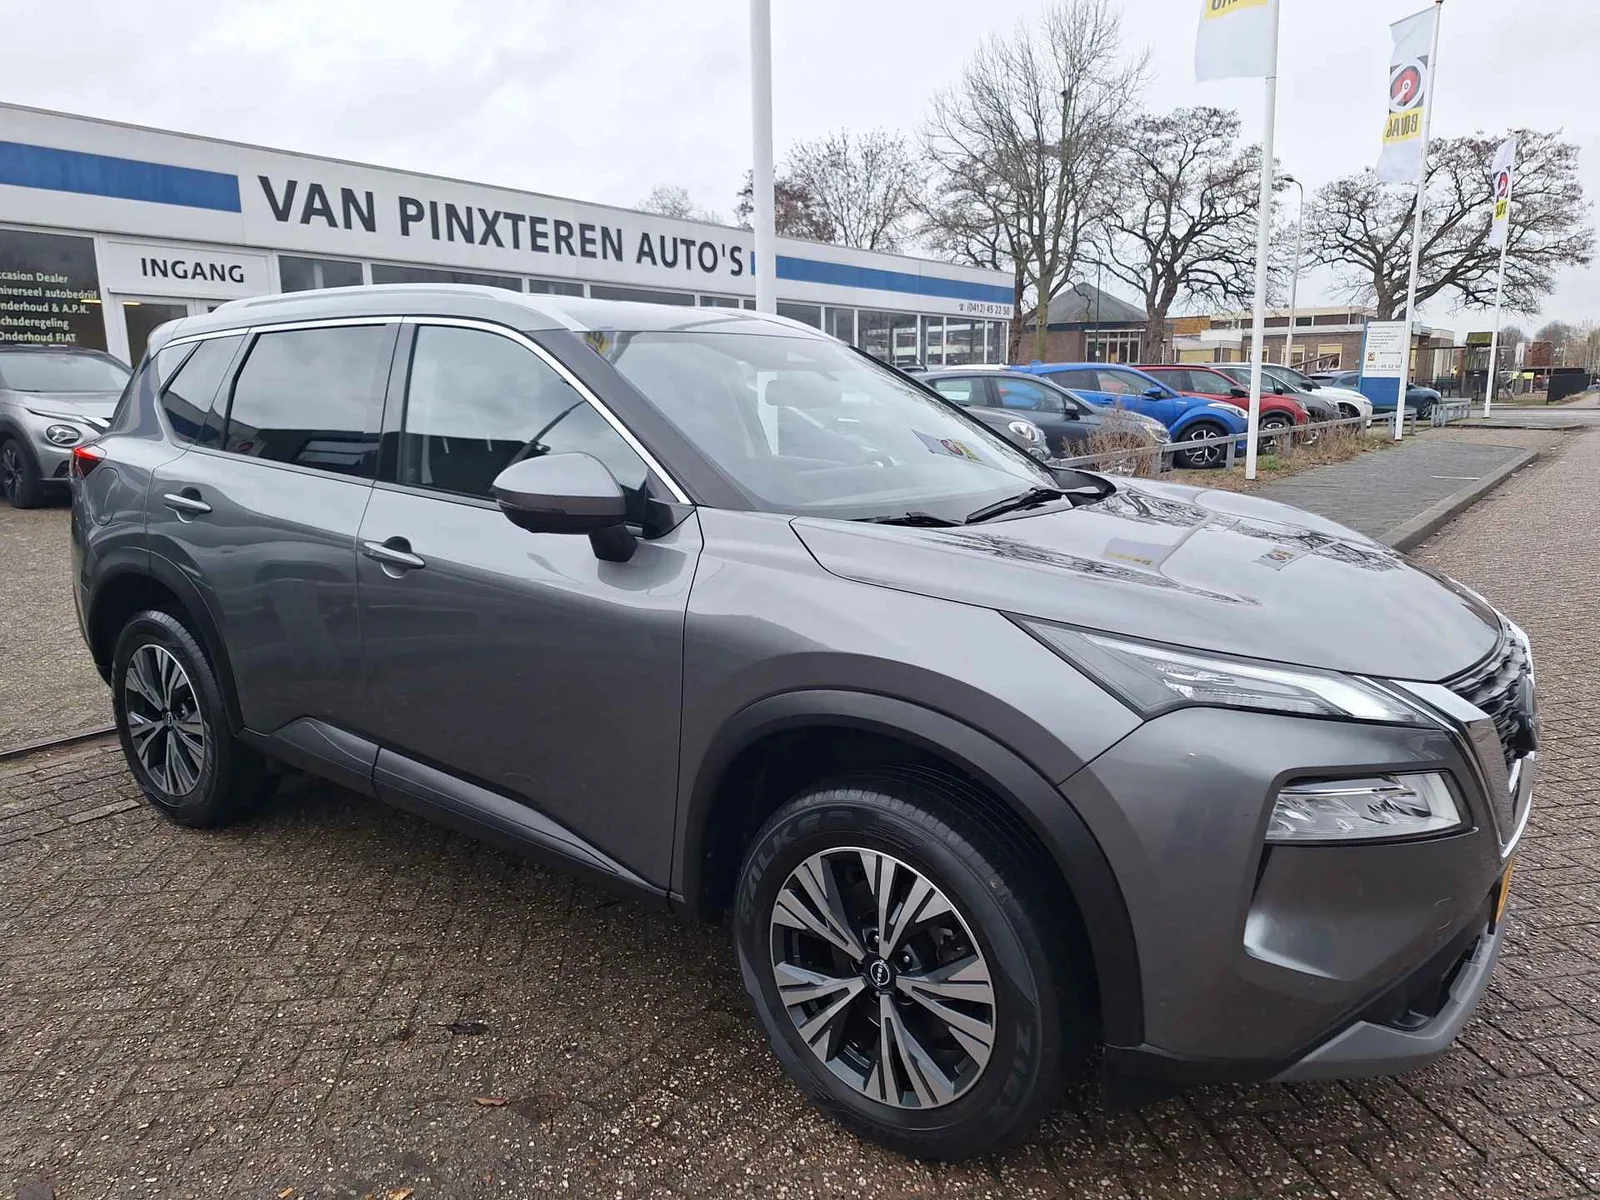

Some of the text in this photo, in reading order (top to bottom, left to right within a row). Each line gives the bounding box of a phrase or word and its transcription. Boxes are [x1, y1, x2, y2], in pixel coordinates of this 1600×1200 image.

[257, 175, 743, 277] VAN PINXTEREN AUTO'S
[141, 257, 244, 283] INGANG
[36, 272, 68, 283] Dealer
[45, 289, 97, 299] autobedrijf
[52, 303, 59, 313] &
[62, 304, 90, 314] A.P.K.
[967, 302, 1011, 316] (0412) 45 22 50
[56, 333, 76, 342] FIAT
